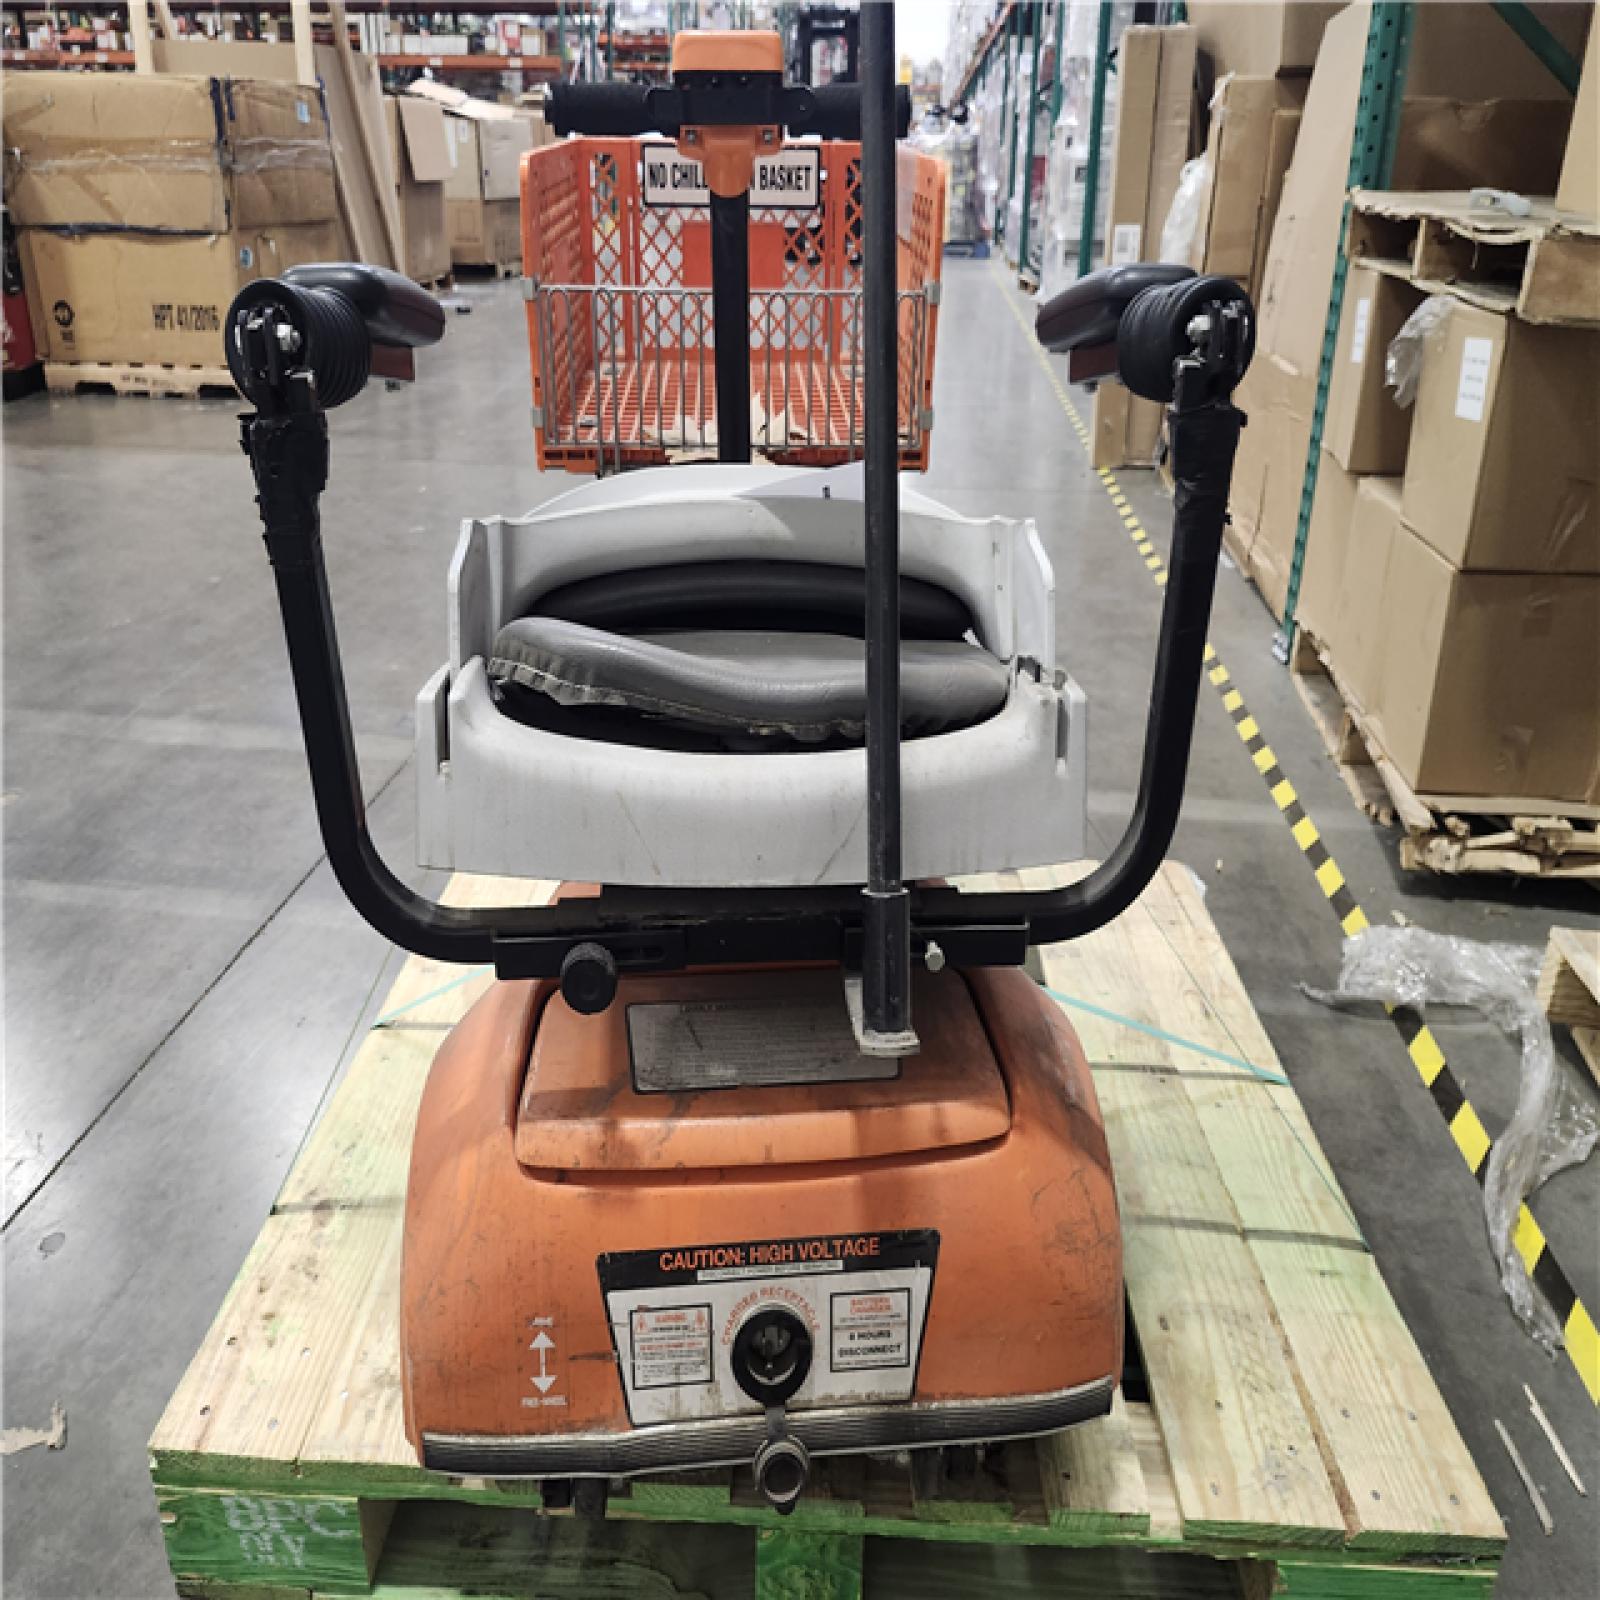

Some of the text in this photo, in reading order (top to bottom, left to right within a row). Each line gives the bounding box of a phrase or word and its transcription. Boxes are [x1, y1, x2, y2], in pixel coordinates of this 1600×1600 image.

[647, 163, 668, 188] NO
[670, 163, 709, 188] CHIL
[760, 164, 813, 190] BASKET
[659, 1247, 747, 1271] CAUTION:
[749, 1243, 794, 1265] HIGH
[799, 1236, 881, 1260] VOLTAGE
[839, 1344, 901, 1358] DISCONNECT
